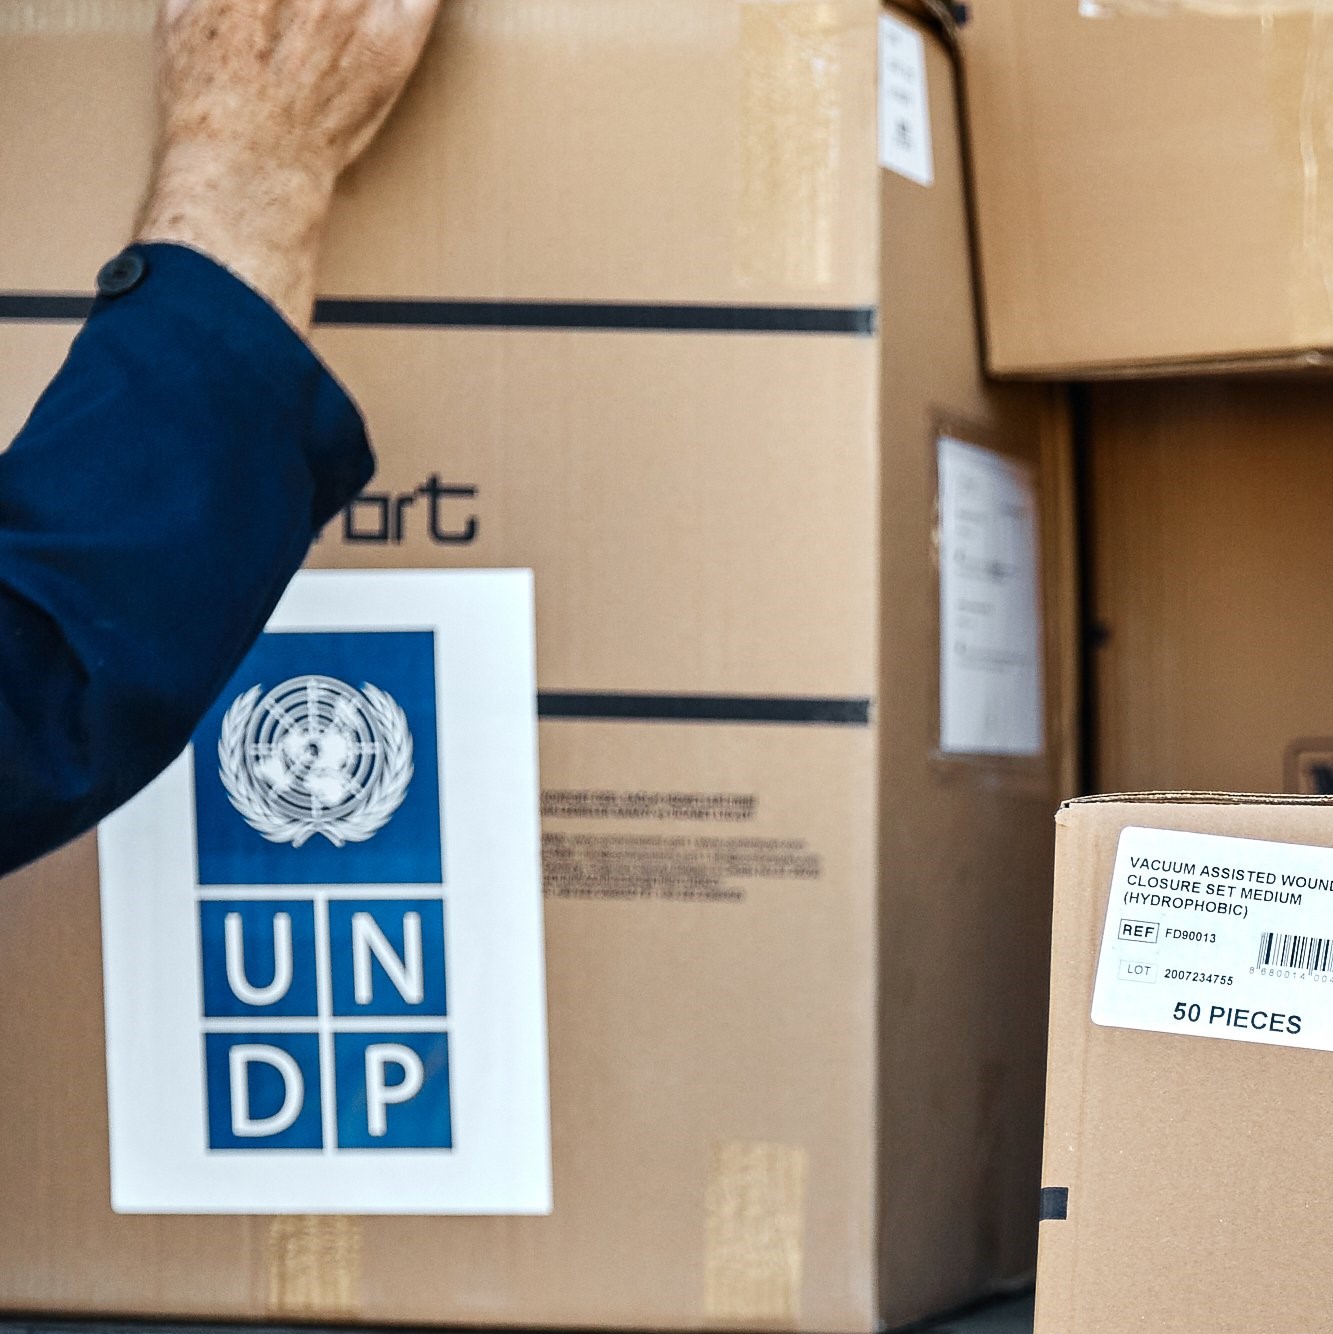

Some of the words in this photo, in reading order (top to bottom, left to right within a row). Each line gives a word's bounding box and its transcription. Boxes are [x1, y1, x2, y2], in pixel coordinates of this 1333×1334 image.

[1130, 857, 1196, 875] VACUUM
[1200, 865, 1277, 885] ASSISTED
[1127, 874, 1202, 894] CLOSURE
[1205, 883, 1237, 898] SET
[1240, 888, 1303, 906] MEDIUM
[1123, 891, 1249, 919] (HYDROPHOBIC)
[1123, 923, 1156, 939] REF
[1165, 928, 1217, 944] FD90013
[1127, 965, 1152, 977] LOT
[1164, 968, 1235, 986] 2007234755
[1173, 1001, 1201, 1023] 50
[1209, 1005, 1302, 1035] PIECES
